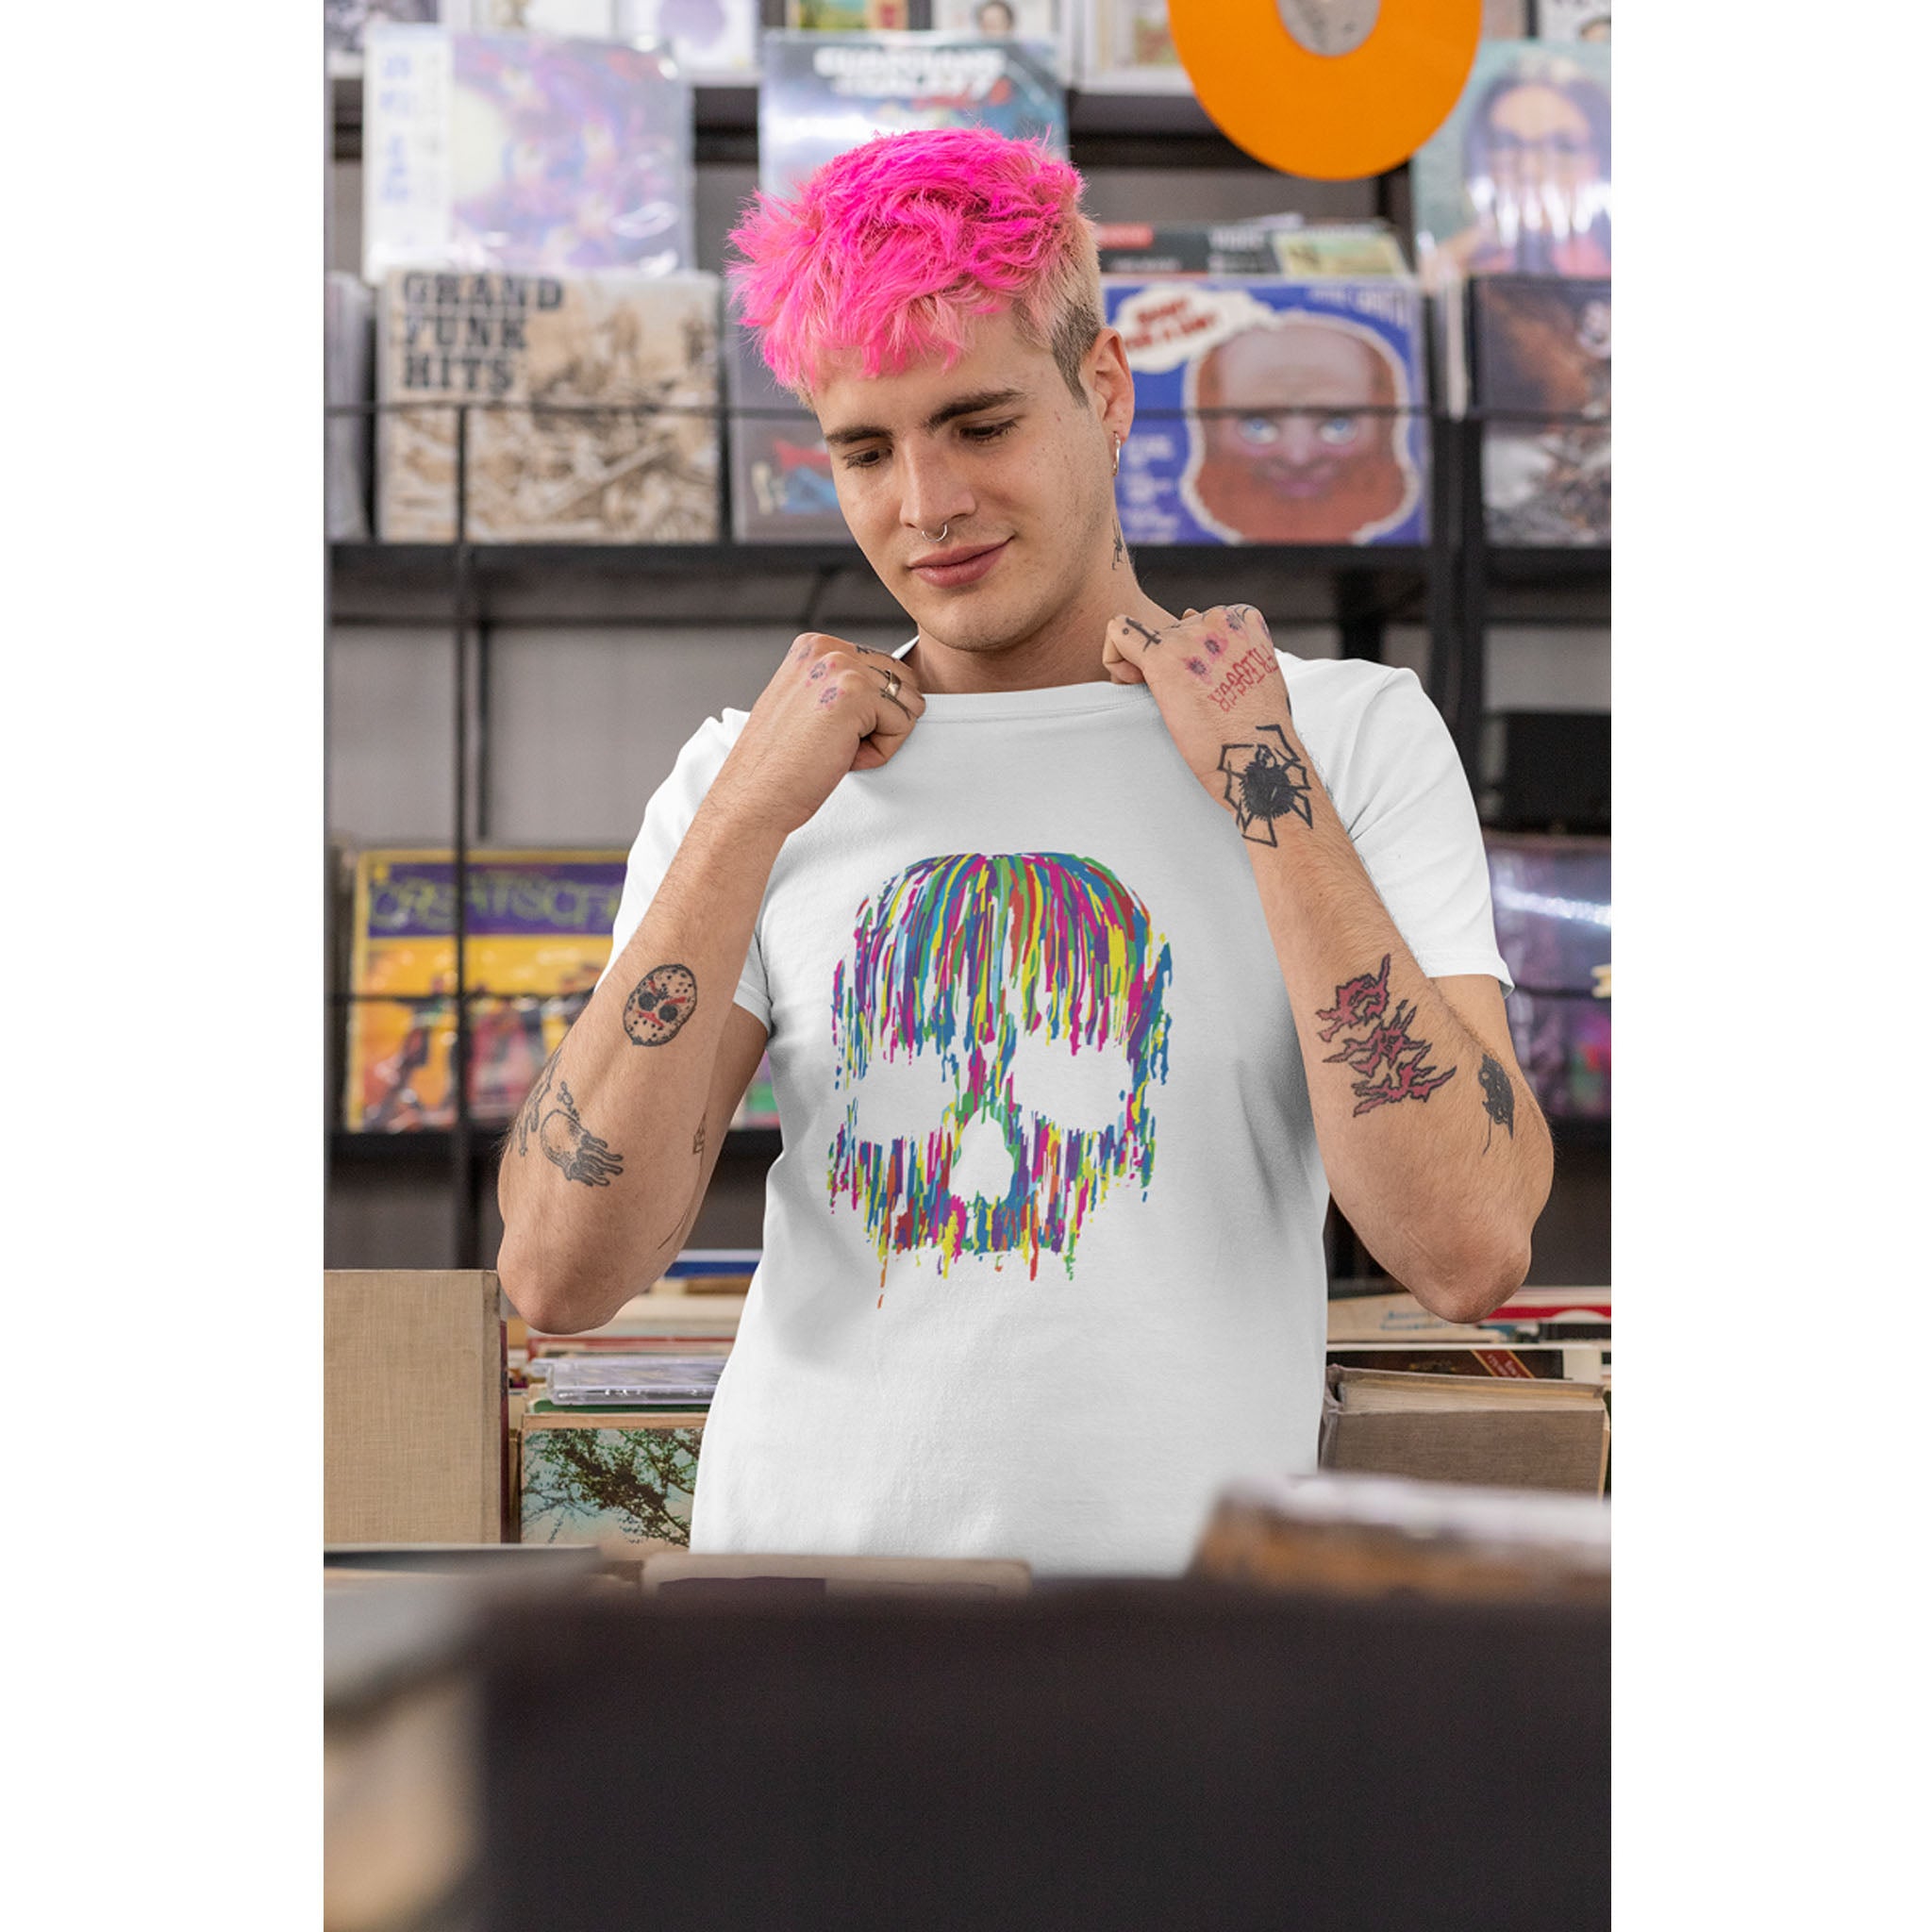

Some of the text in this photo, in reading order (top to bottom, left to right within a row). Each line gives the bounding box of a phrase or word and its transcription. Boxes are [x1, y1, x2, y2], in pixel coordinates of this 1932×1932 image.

[403, 272, 563, 309] GRAND
[404, 312, 526, 350] FUNK
[404, 353, 514, 394] HITS
